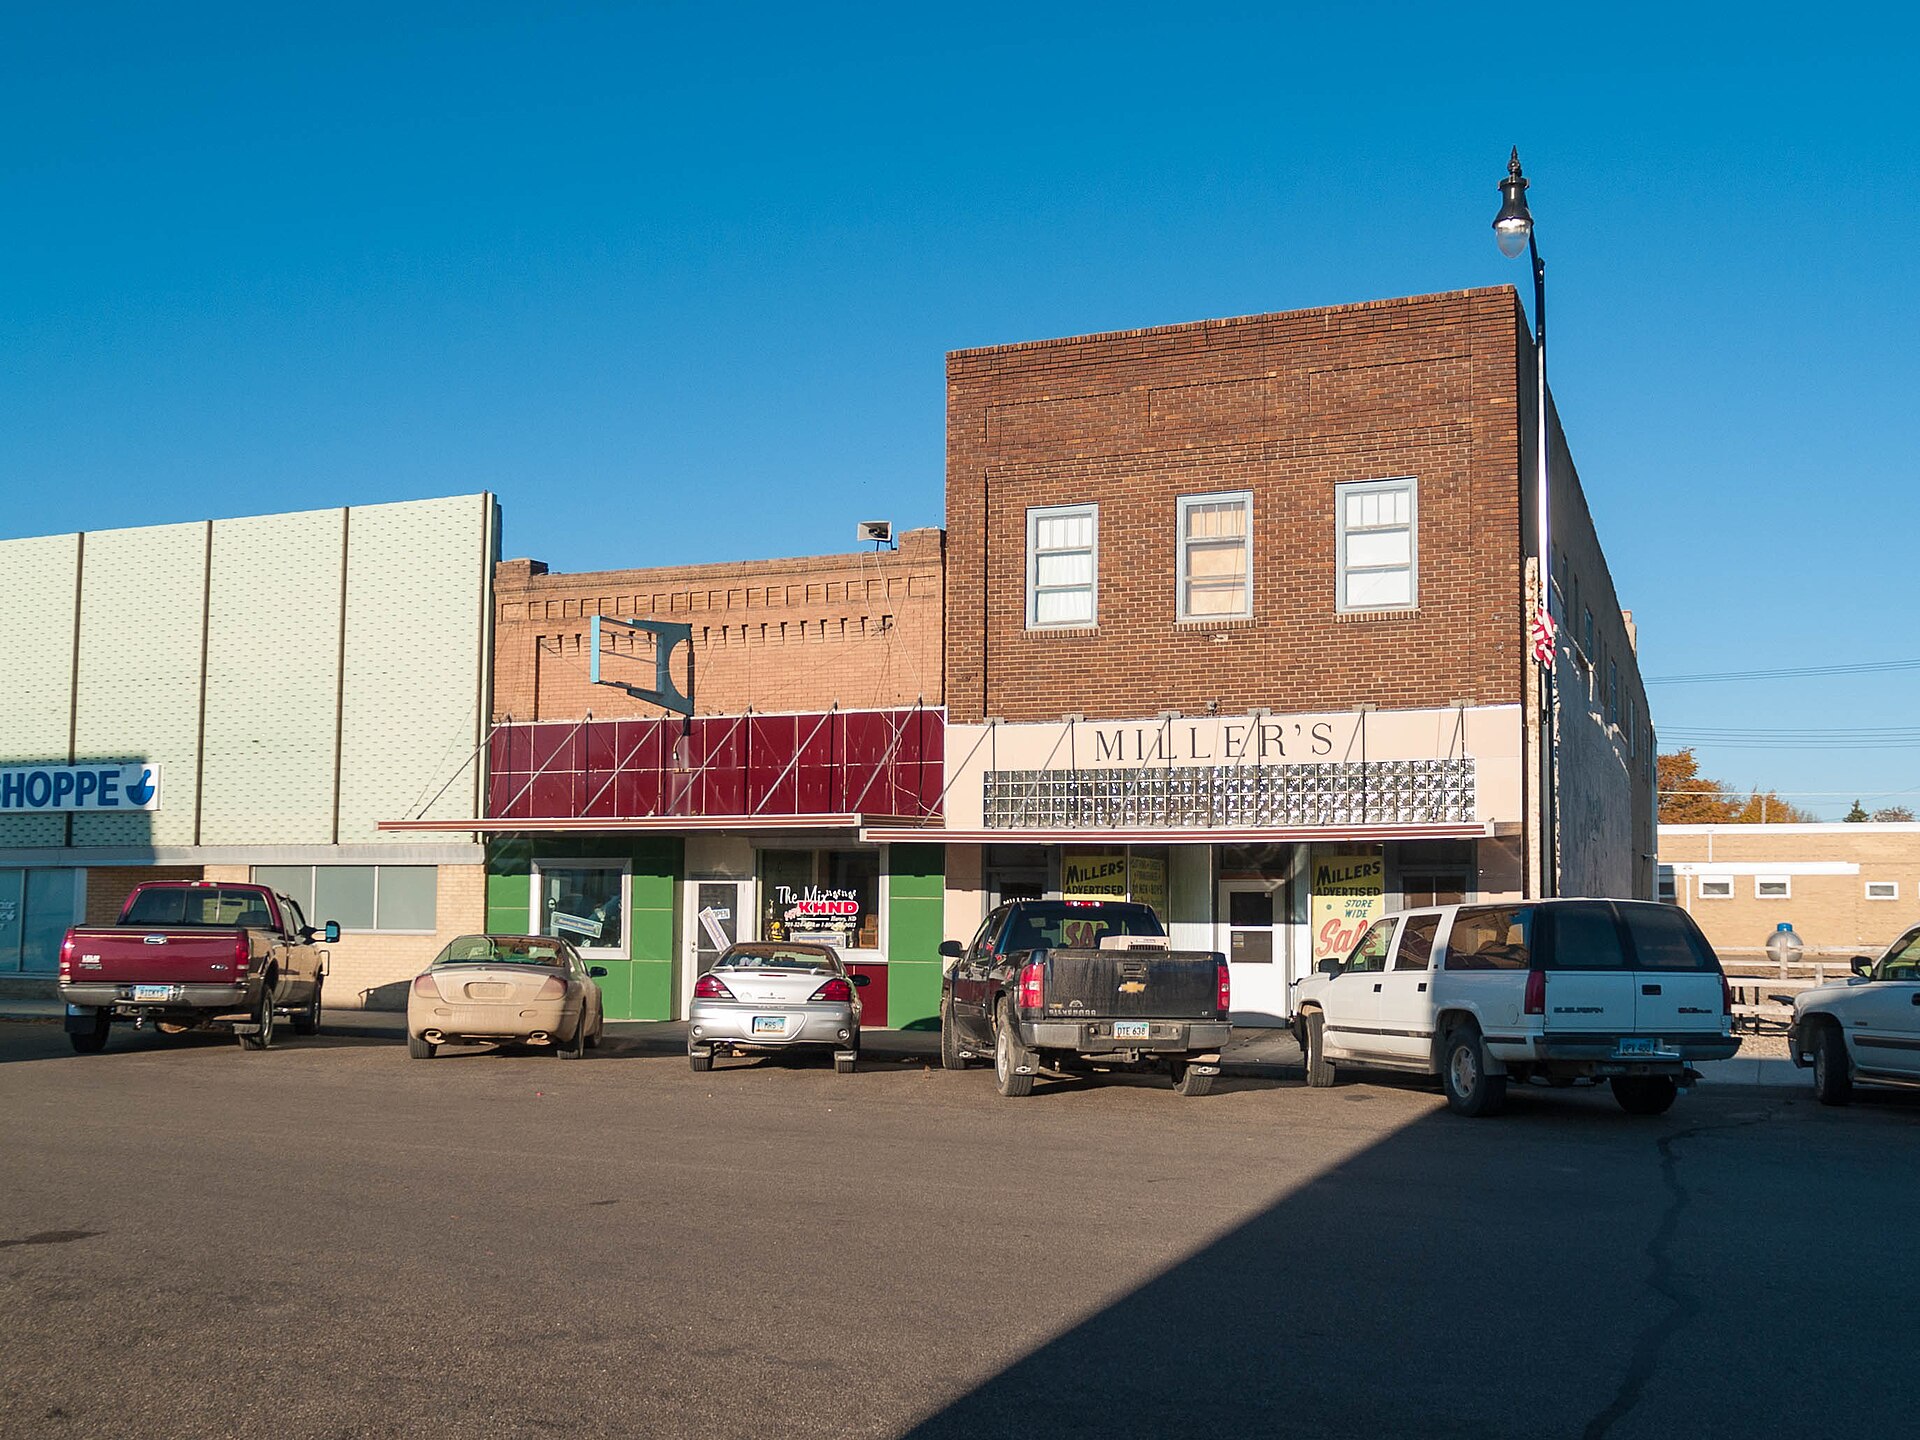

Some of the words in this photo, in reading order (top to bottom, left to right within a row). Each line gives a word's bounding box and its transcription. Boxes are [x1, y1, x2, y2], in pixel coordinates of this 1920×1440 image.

[1095, 722, 1333, 762] MILLER'S
[0, 770, 120, 808] HOPPE
[1066, 860, 1125, 886] MILLERS
[1316, 861, 1381, 887] MILLERS
[775, 886, 798, 904] The
[1065, 885, 1124, 895] ADVERTISED
[1316, 886, 1381, 896] ADVERTISED
[798, 900, 859, 915] KHND
[1344, 899, 1374, 908] STORE
[1344, 909, 1368, 918] WIDE
[1132, 1027, 1146, 1036] 638
